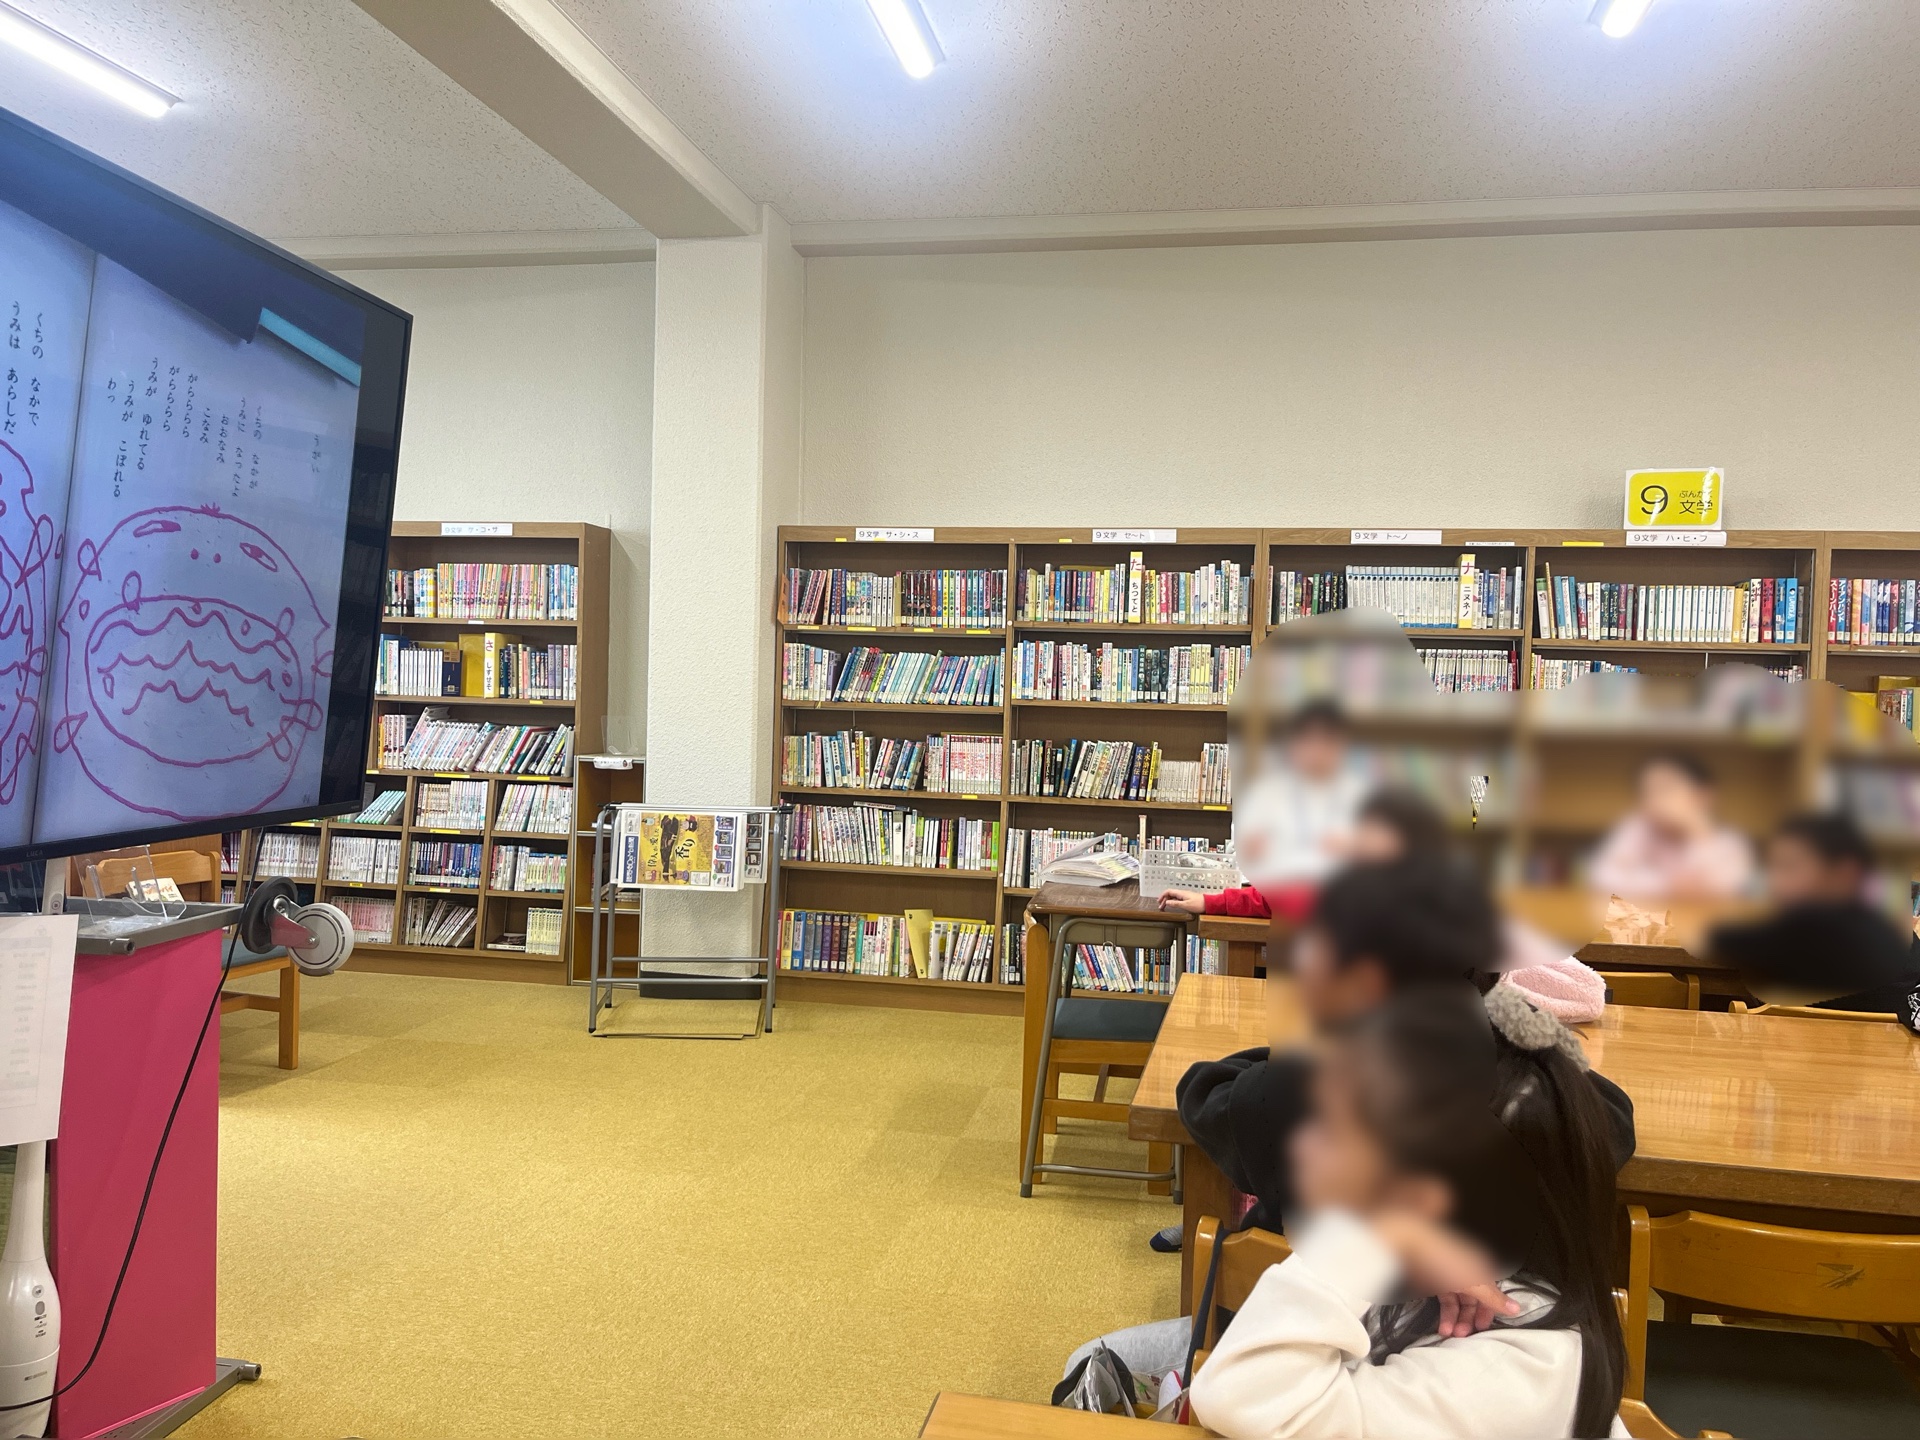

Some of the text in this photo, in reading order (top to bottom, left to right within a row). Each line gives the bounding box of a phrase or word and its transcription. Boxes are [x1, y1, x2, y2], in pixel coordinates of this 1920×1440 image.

[4, 301, 21, 434] うみは あらしだ
[29, 312, 43, 426] くちの なかで
[107, 378, 116, 403] わっ
[163, 365, 180, 431] がらららら
[182, 374, 198, 438] がらららら
[137, 357, 158, 470] うみが ゆれてる
[199, 407, 211, 443] こなみ
[113, 380, 134, 497] うみが こぼれる
[216, 414, 229, 463] おおなみ
[311, 434, 321, 473] うがい
[1640, 485, 1668, 515] 9
[1679, 500, 1713, 515] 文学
[858, 530, 919, 539] 9文学 サ・シ・ス
[1095, 531, 1118, 539] 9文学
[1354, 532, 1378, 540] 9文学
[1633, 534, 1658, 542] 9文学
[1130, 558, 1142, 571] た
[1461, 561, 1474, 575] ナ
[1131, 582, 1139, 613] ちつてと
[1462, 586, 1471, 617] ニヌネノ
[674, 838, 696, 860] 香り
